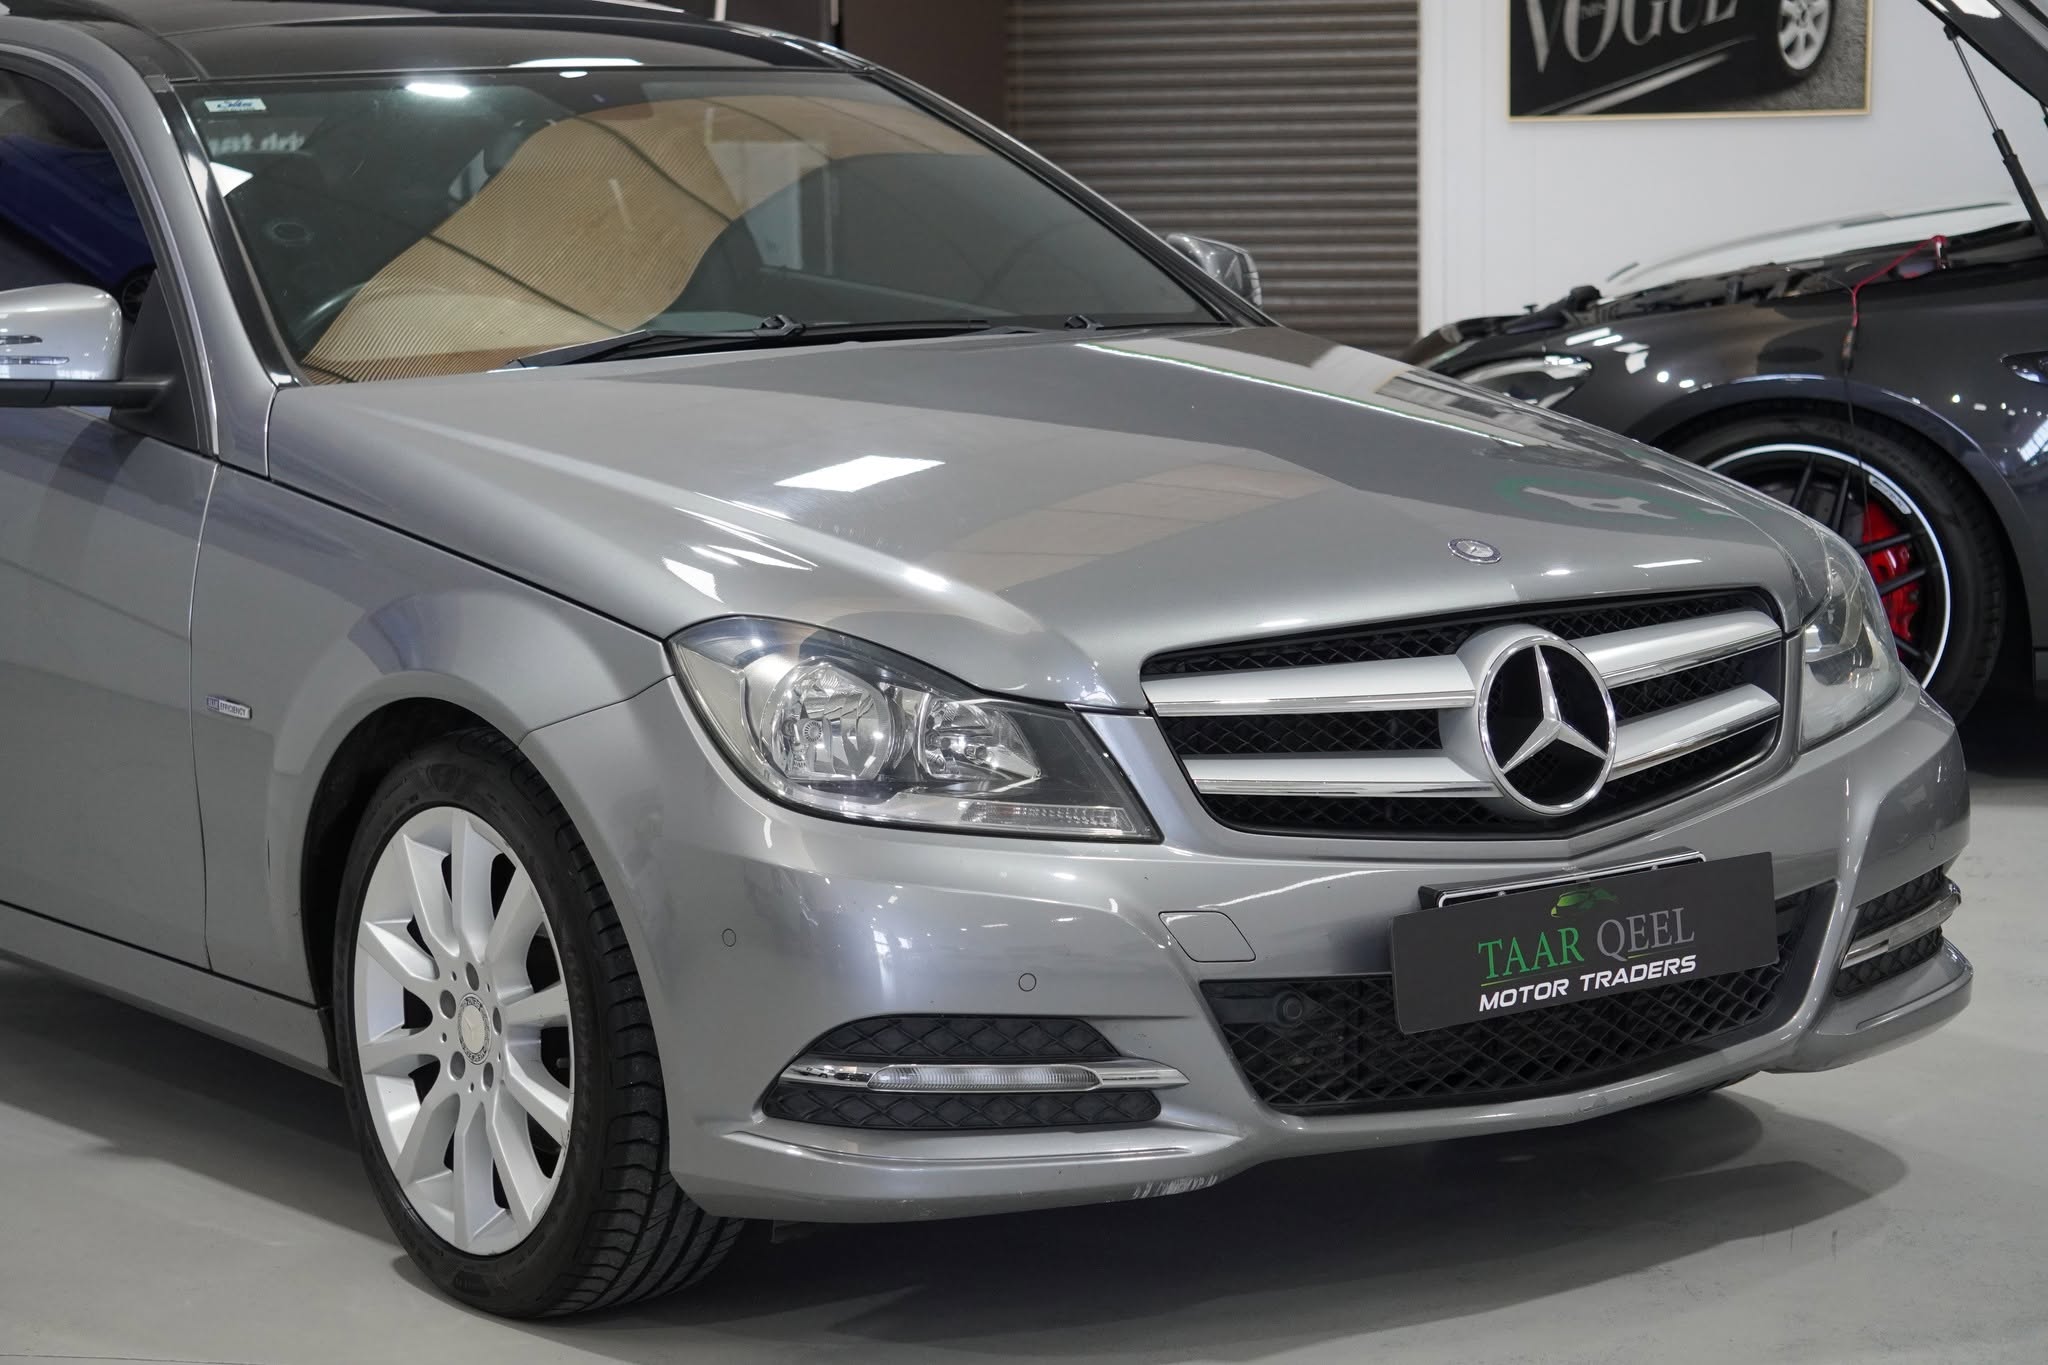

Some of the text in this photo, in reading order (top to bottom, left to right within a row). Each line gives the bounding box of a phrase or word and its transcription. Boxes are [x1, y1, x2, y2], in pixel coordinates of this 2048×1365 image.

[1478, 907, 1695, 980] TAAR QEEL
[1479, 954, 1697, 1012] MOTOR TRADERS
